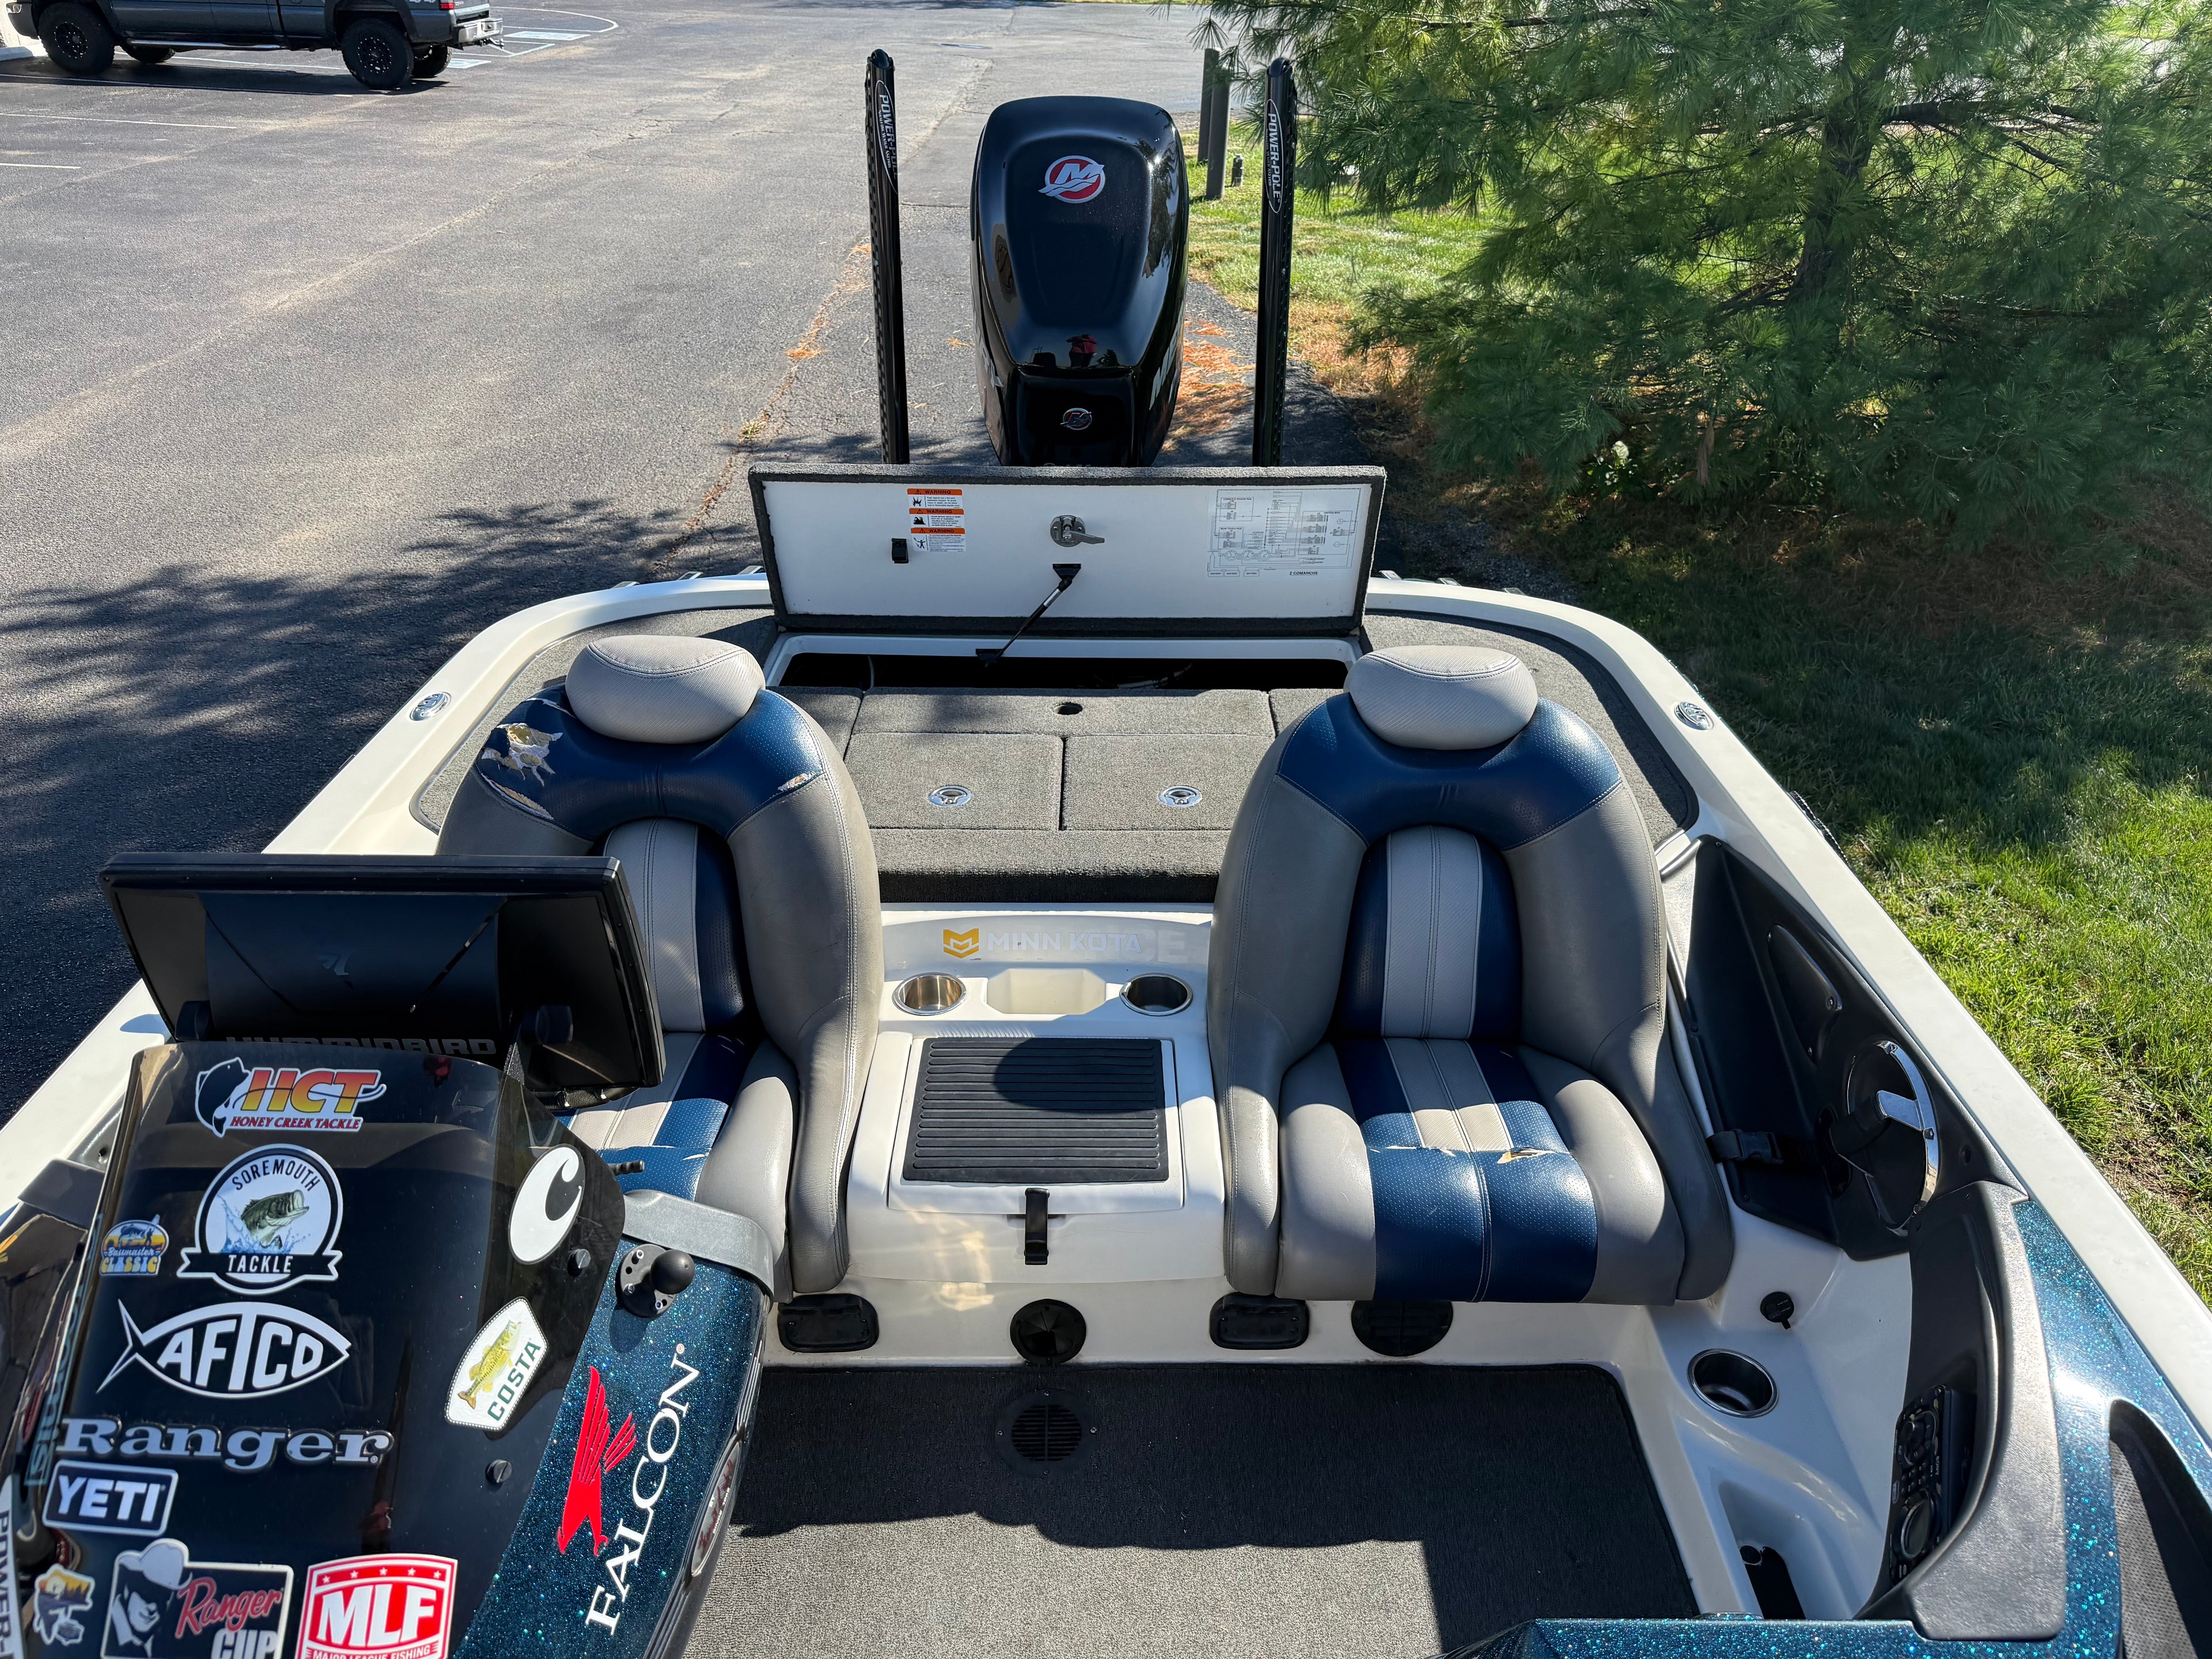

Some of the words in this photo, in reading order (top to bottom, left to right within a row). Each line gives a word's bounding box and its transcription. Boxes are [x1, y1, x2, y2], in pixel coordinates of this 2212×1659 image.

[1268, 113, 1282, 199] POWER-POLE
[987, 932, 1061, 951] MINN
[1069, 933, 1142, 953] KOTA
[230, 1116, 275, 1127] HONEY
[274, 1117, 315, 1128] CREEK
[315, 1118, 361, 1130] TACKLE
[232, 1158, 321, 1192] SOREMOUTH
[101, 1256, 158, 1273] CLASSIC
[107, 1246, 155, 1256] Bassmaster
[228, 1255, 293, 1272] TACKLE
[156, 1313, 324, 1391] AFTCO
[487, 1341, 542, 1422] COSTA
[56, 1417, 390, 1470] Ranger
[58, 1474, 161, 1522] YETI
[585, 1353, 700, 1635] FALCON
[175, 1575, 283, 1639] Ranger
[316, 1584, 437, 1647] MLF
[210, 1628, 279, 1659] CUP
